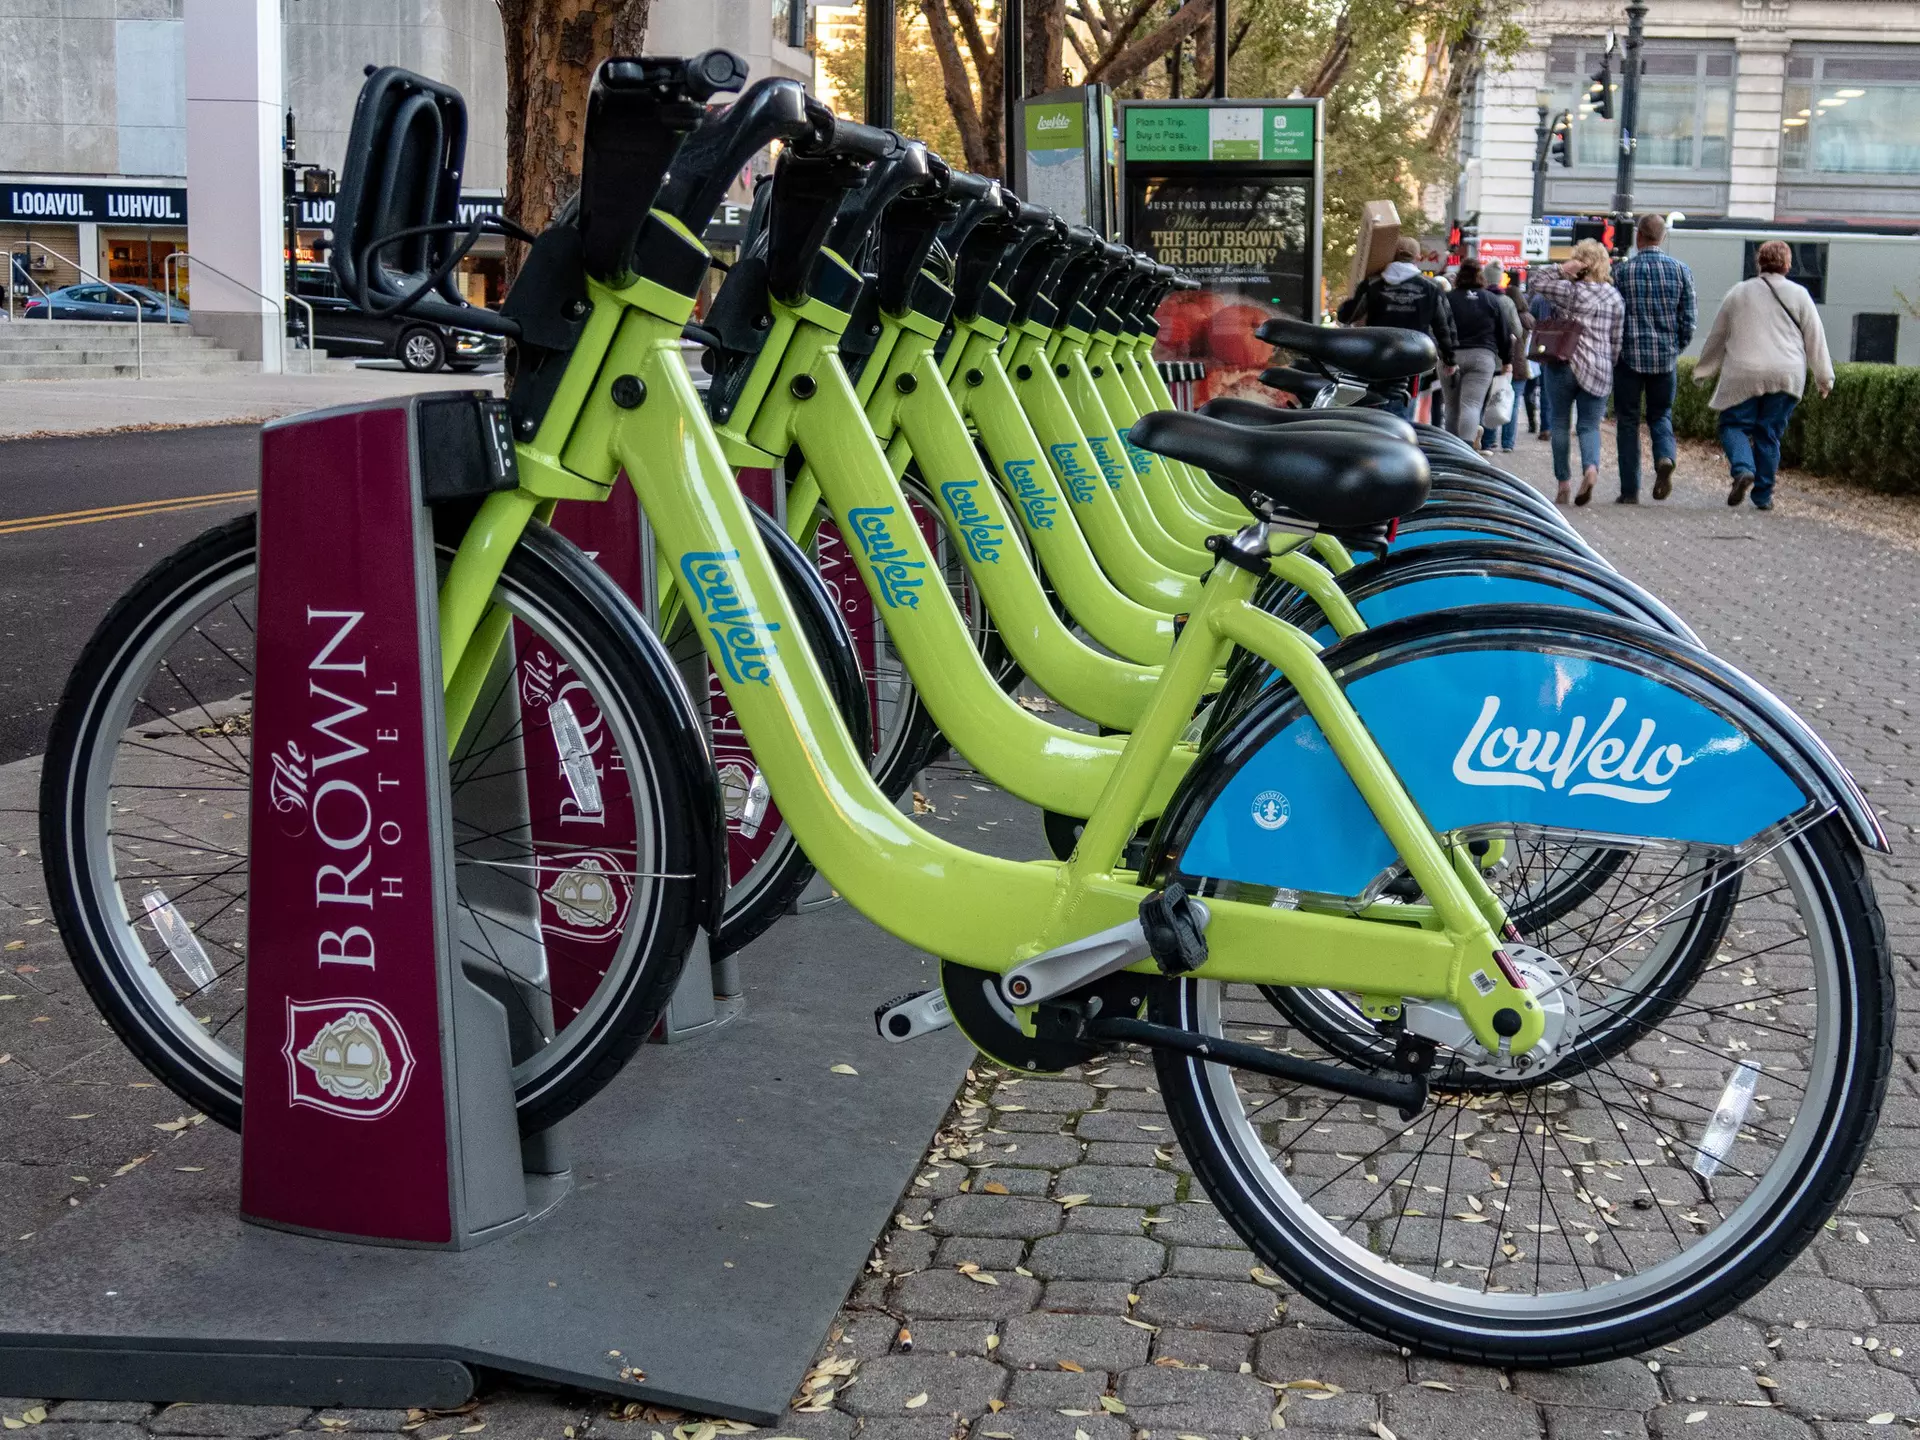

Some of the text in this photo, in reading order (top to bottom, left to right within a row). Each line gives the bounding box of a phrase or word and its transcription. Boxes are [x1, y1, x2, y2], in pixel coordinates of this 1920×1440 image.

[1037, 113, 1072, 130] LouVelo
[1135, 118, 1155, 126] Plan
[1166, 117, 1187, 128] Trip.
[1136, 131, 1152, 140] Buy
[1163, 131, 1187, 139] Pass.
[1136, 144, 1166, 152] Unlock
[12, 191, 181, 219] LOOAVUL. LUHVUL.
[1148, 201, 1174, 210] JUST
[1178, 201, 1206, 210] FOUR
[1210, 201, 1252, 210] BLOCKS
[1165, 212, 1209, 230] Which
[1151, 231, 1285, 247] THE HOT BROWN
[1526, 237, 1545, 246] WAY
[1527, 228, 1544, 236] ONE
[1159, 249, 1277, 264] OR BOURBON?
[1050, 442, 1097, 504] LouVelo
[1086, 437, 1124, 491] LouVelo
[1004, 459, 1057, 530] LouVelo
[940, 479, 1004, 564] LouVelo
[848, 505, 926, 610] LouVelo
[680, 548, 781, 688] LouVelo
[522, 651, 554, 714] The
[1452, 695, 1695, 804] LouVelo
[268, 740, 308, 836] The
[306, 604, 376, 972] BROWN
[375, 681, 403, 899] HOTEL
